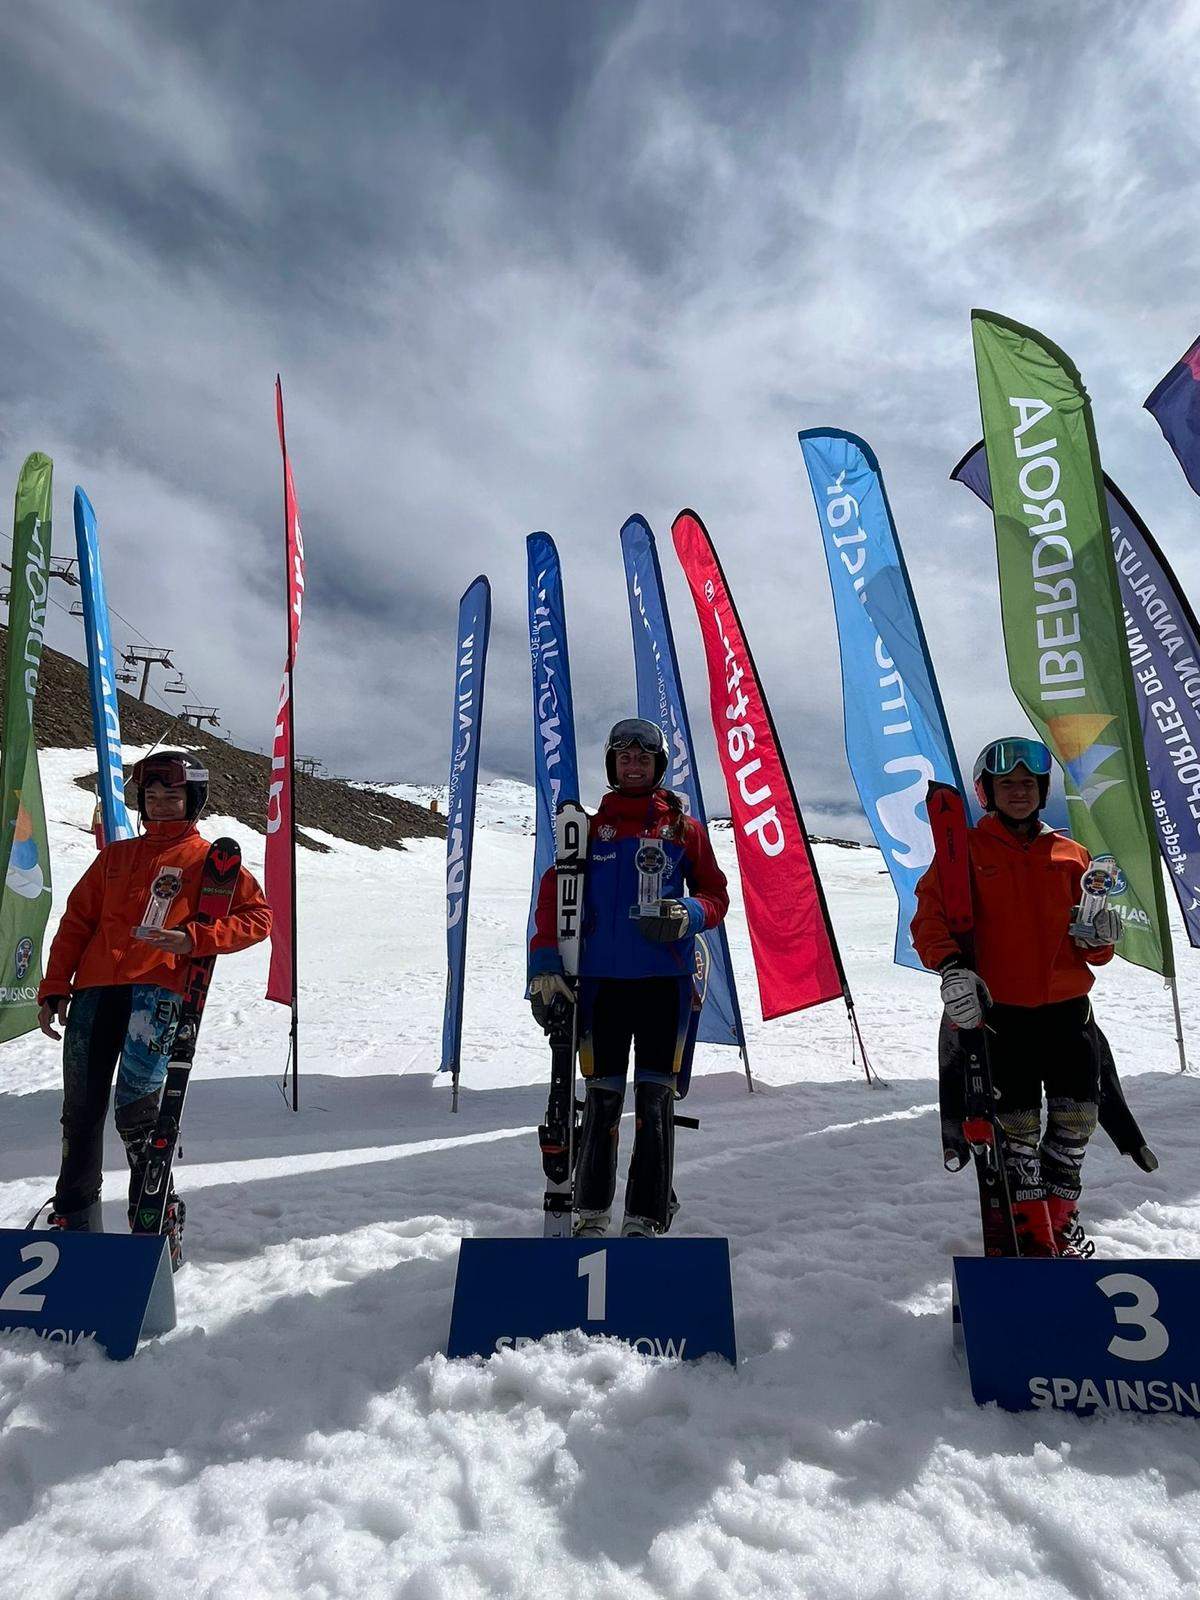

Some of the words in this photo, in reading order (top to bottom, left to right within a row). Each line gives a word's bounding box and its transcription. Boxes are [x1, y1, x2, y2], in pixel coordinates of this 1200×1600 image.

[0, 1241, 60, 1312] 2
[577, 1248, 608, 1321] 1
[1096, 1273, 1170, 1362] 3
